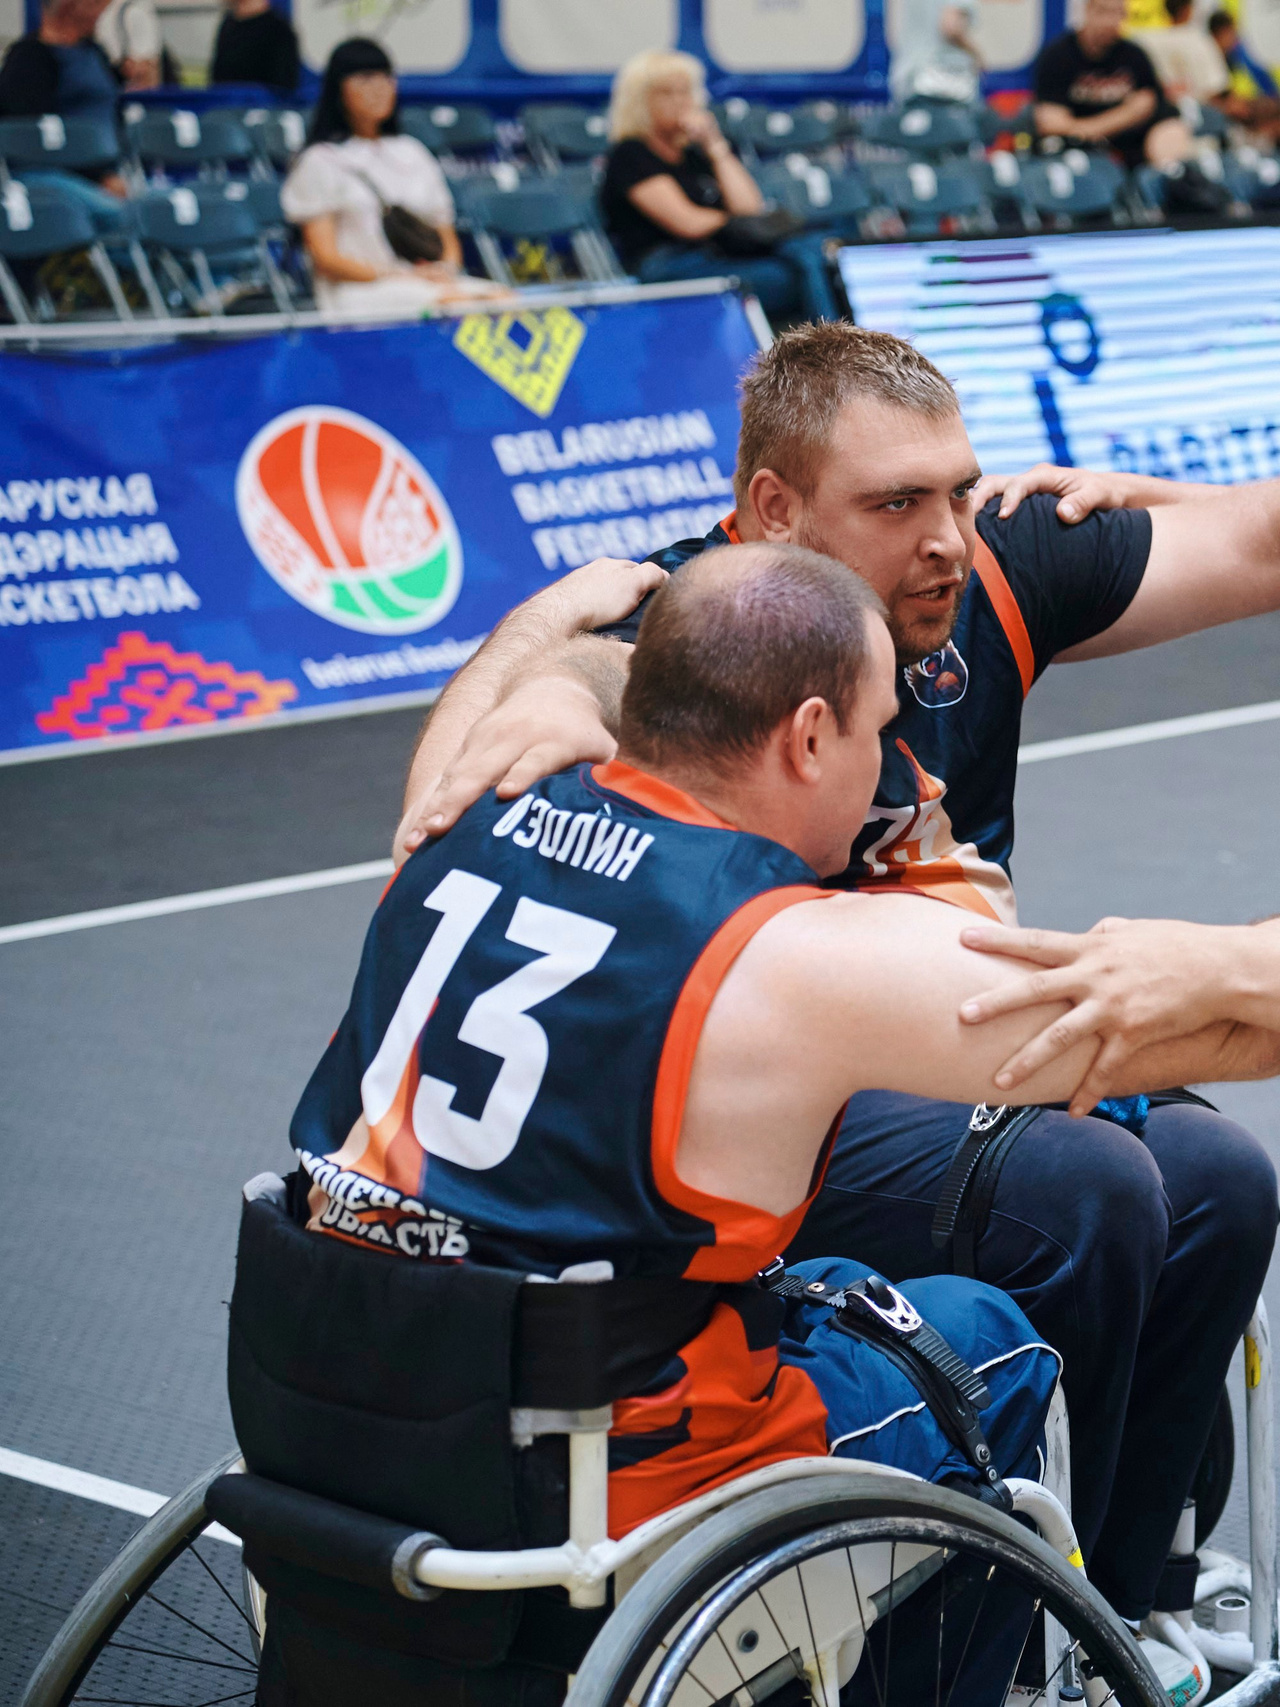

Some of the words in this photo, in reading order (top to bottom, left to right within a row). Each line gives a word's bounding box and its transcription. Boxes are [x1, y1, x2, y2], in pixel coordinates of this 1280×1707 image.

[491, 408, 717, 476] BELARUSIAN
[511, 456, 734, 524] BASKETBALL
[0, 571, 201, 626] СКЕТБОЛА
[361, 869, 618, 1171] 13
